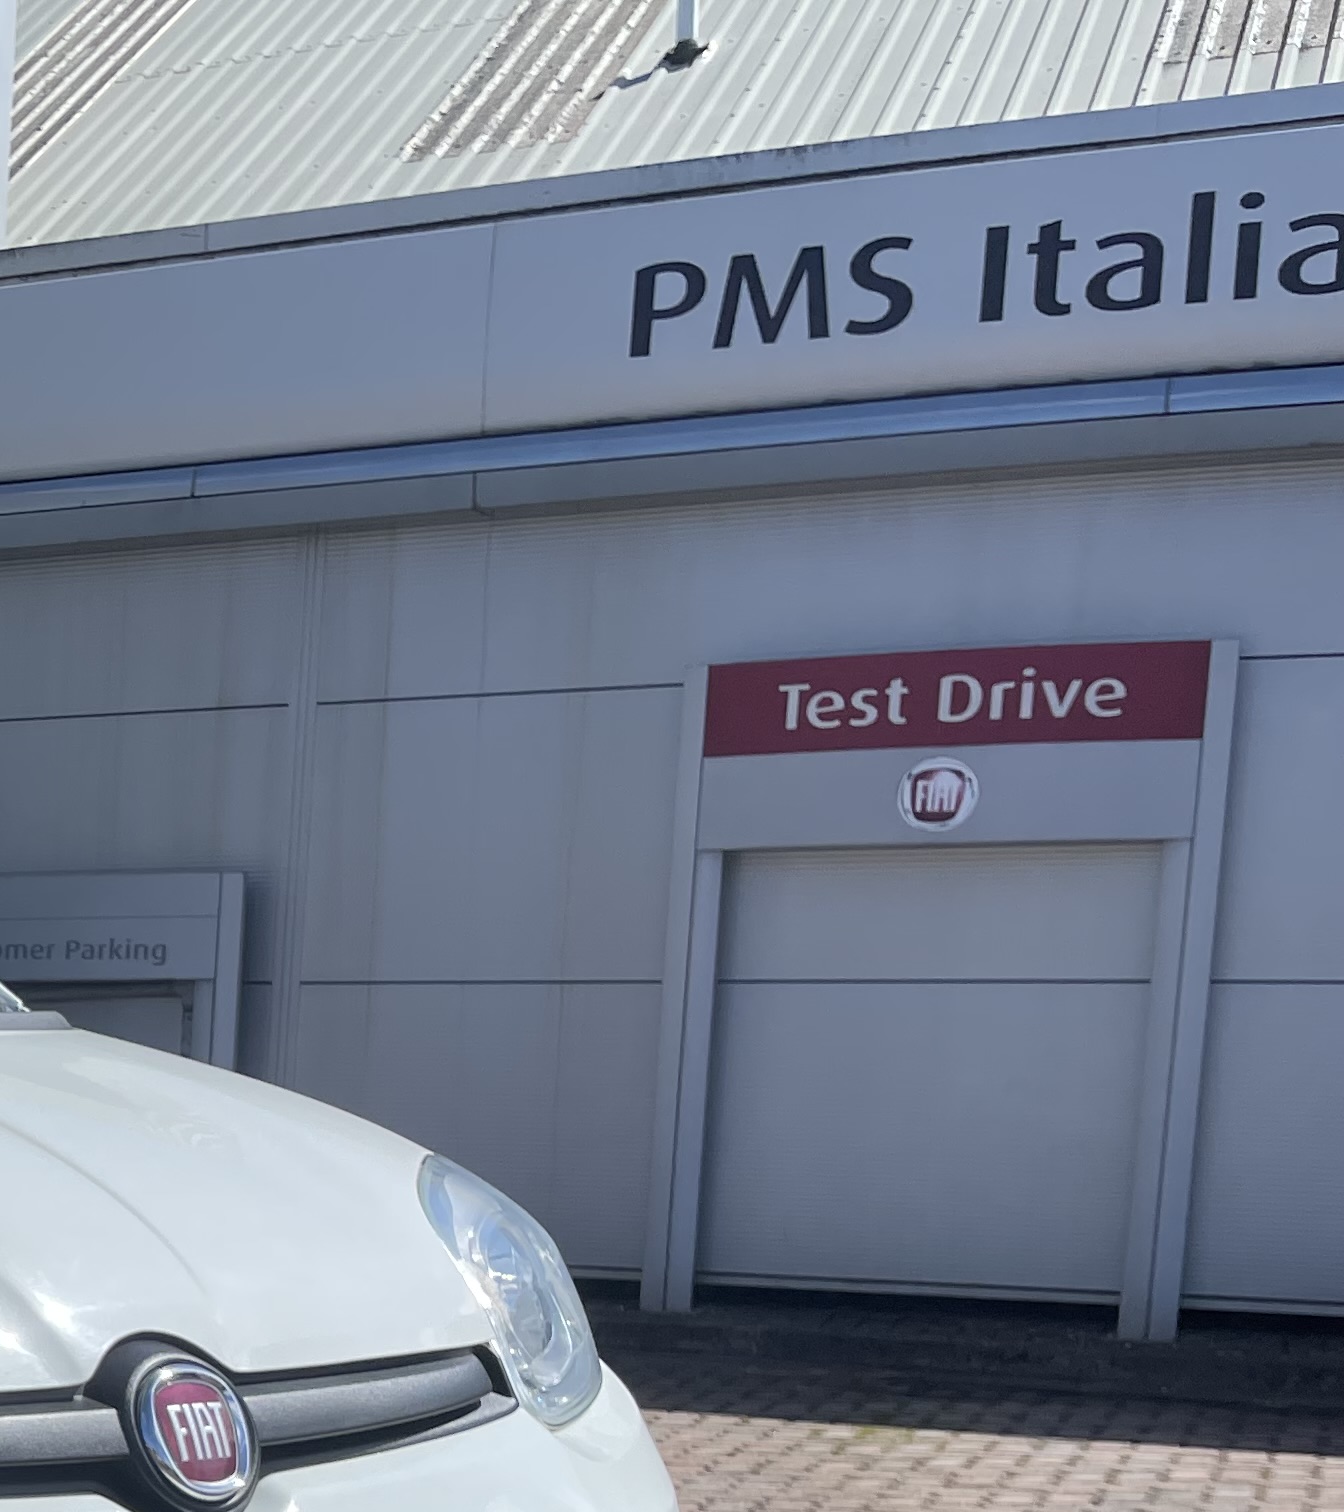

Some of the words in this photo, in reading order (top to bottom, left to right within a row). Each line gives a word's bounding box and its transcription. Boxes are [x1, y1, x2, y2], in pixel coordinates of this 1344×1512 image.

[629, 235, 914, 358] PMS
[979, 191, 1344, 324] Italia
[778, 675, 909, 732] Test
[937, 666, 1128, 724] Drive
[915, 777, 964, 813] FIAT
[65, 938, 167, 966] Parking
[167, 1401, 232, 1463] FIAT
